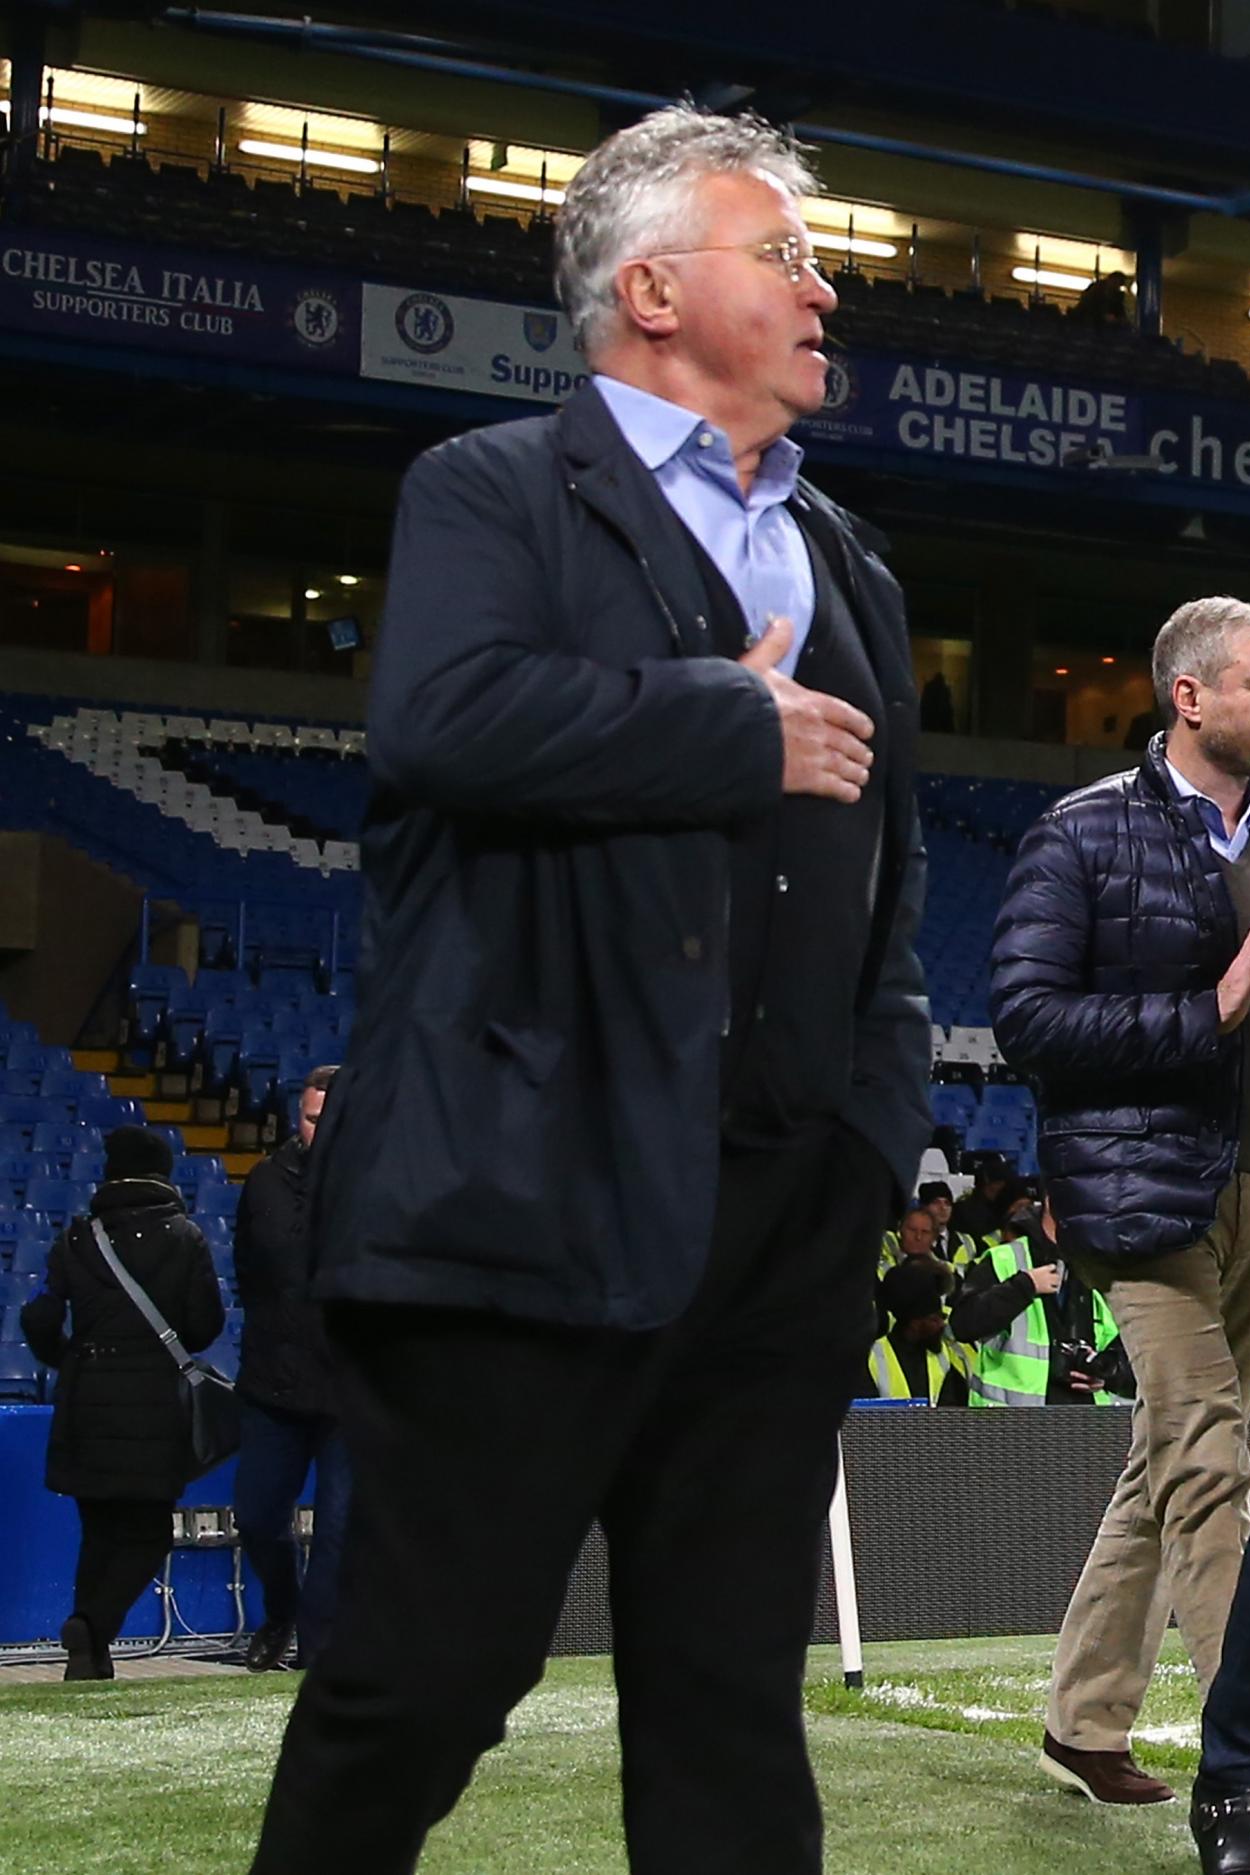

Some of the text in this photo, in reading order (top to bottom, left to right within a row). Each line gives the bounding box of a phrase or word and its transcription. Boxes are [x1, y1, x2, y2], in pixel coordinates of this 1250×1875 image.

[2, 248, 264, 313] CHELSEA ITALIA
[32, 289, 233, 336] SUPPORTERS CLUB
[889, 364, 1127, 432] ADELAIDE
